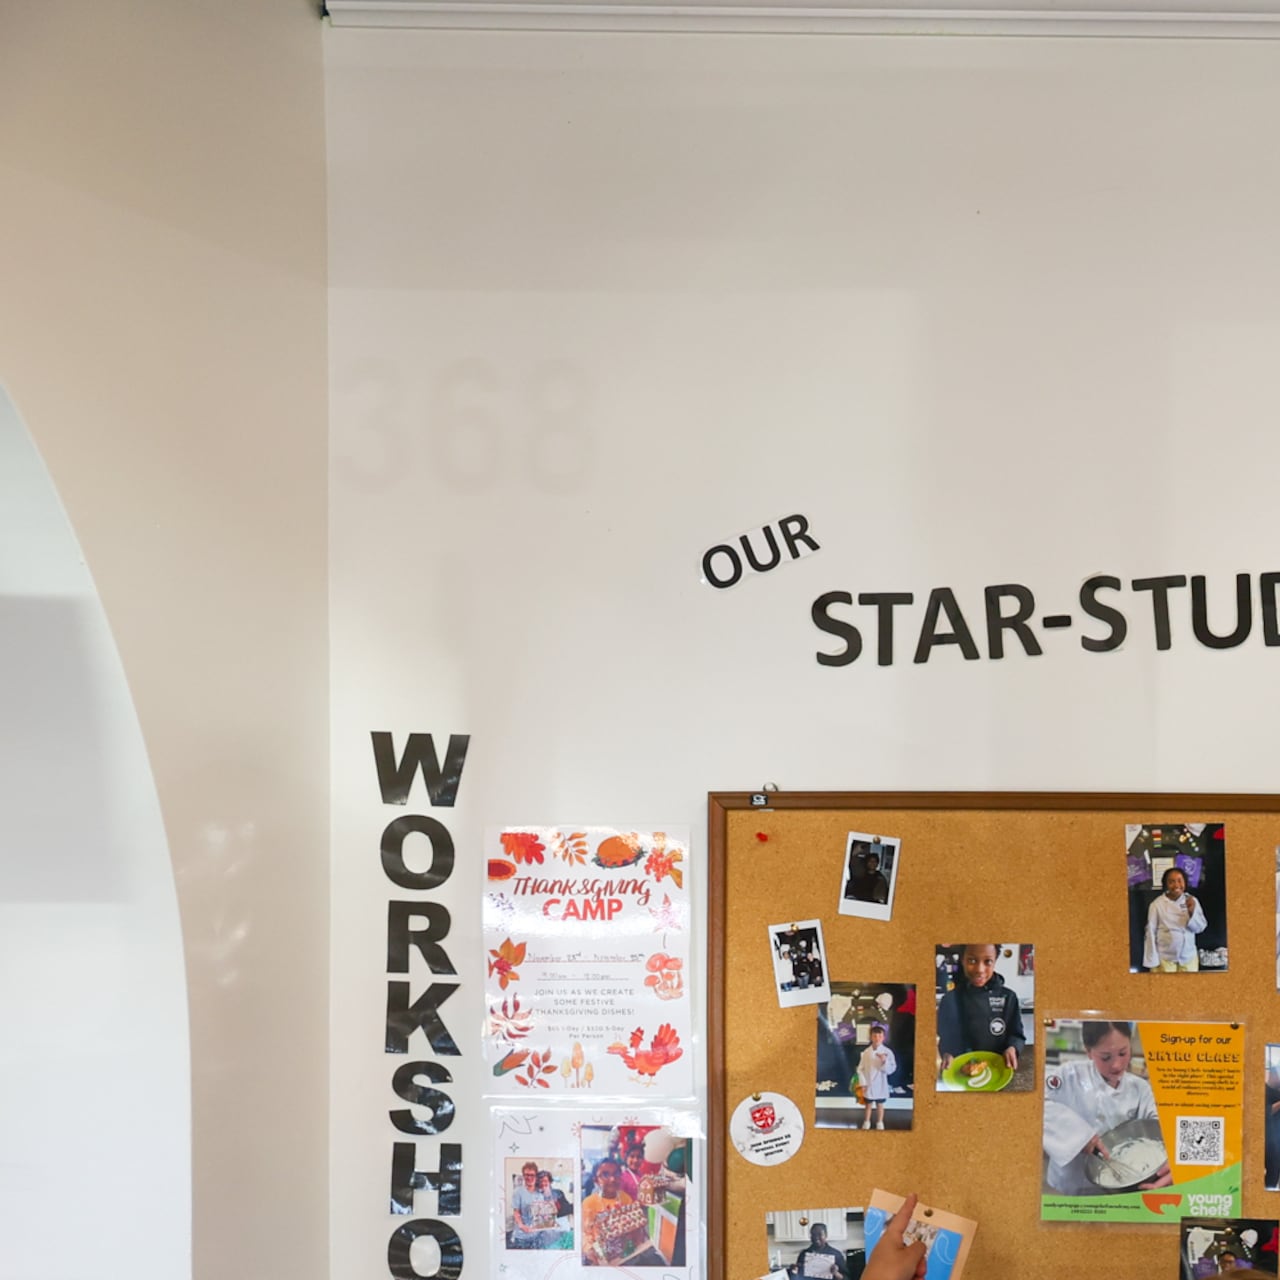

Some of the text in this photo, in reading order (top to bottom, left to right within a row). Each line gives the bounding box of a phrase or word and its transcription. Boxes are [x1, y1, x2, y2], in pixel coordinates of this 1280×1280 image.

[700, 512, 820, 589] OUR
[542, 898, 623, 920] CAMP
[536, 1008, 635, 1016] THANKSGIVING DISHES!
[1160, 1033, 1196, 1046] Sign-up
[1199, 1034, 1212, 1044] for
[1187, 1193, 1232, 1208] young
[1190, 1203, 1231, 1216] chefs
